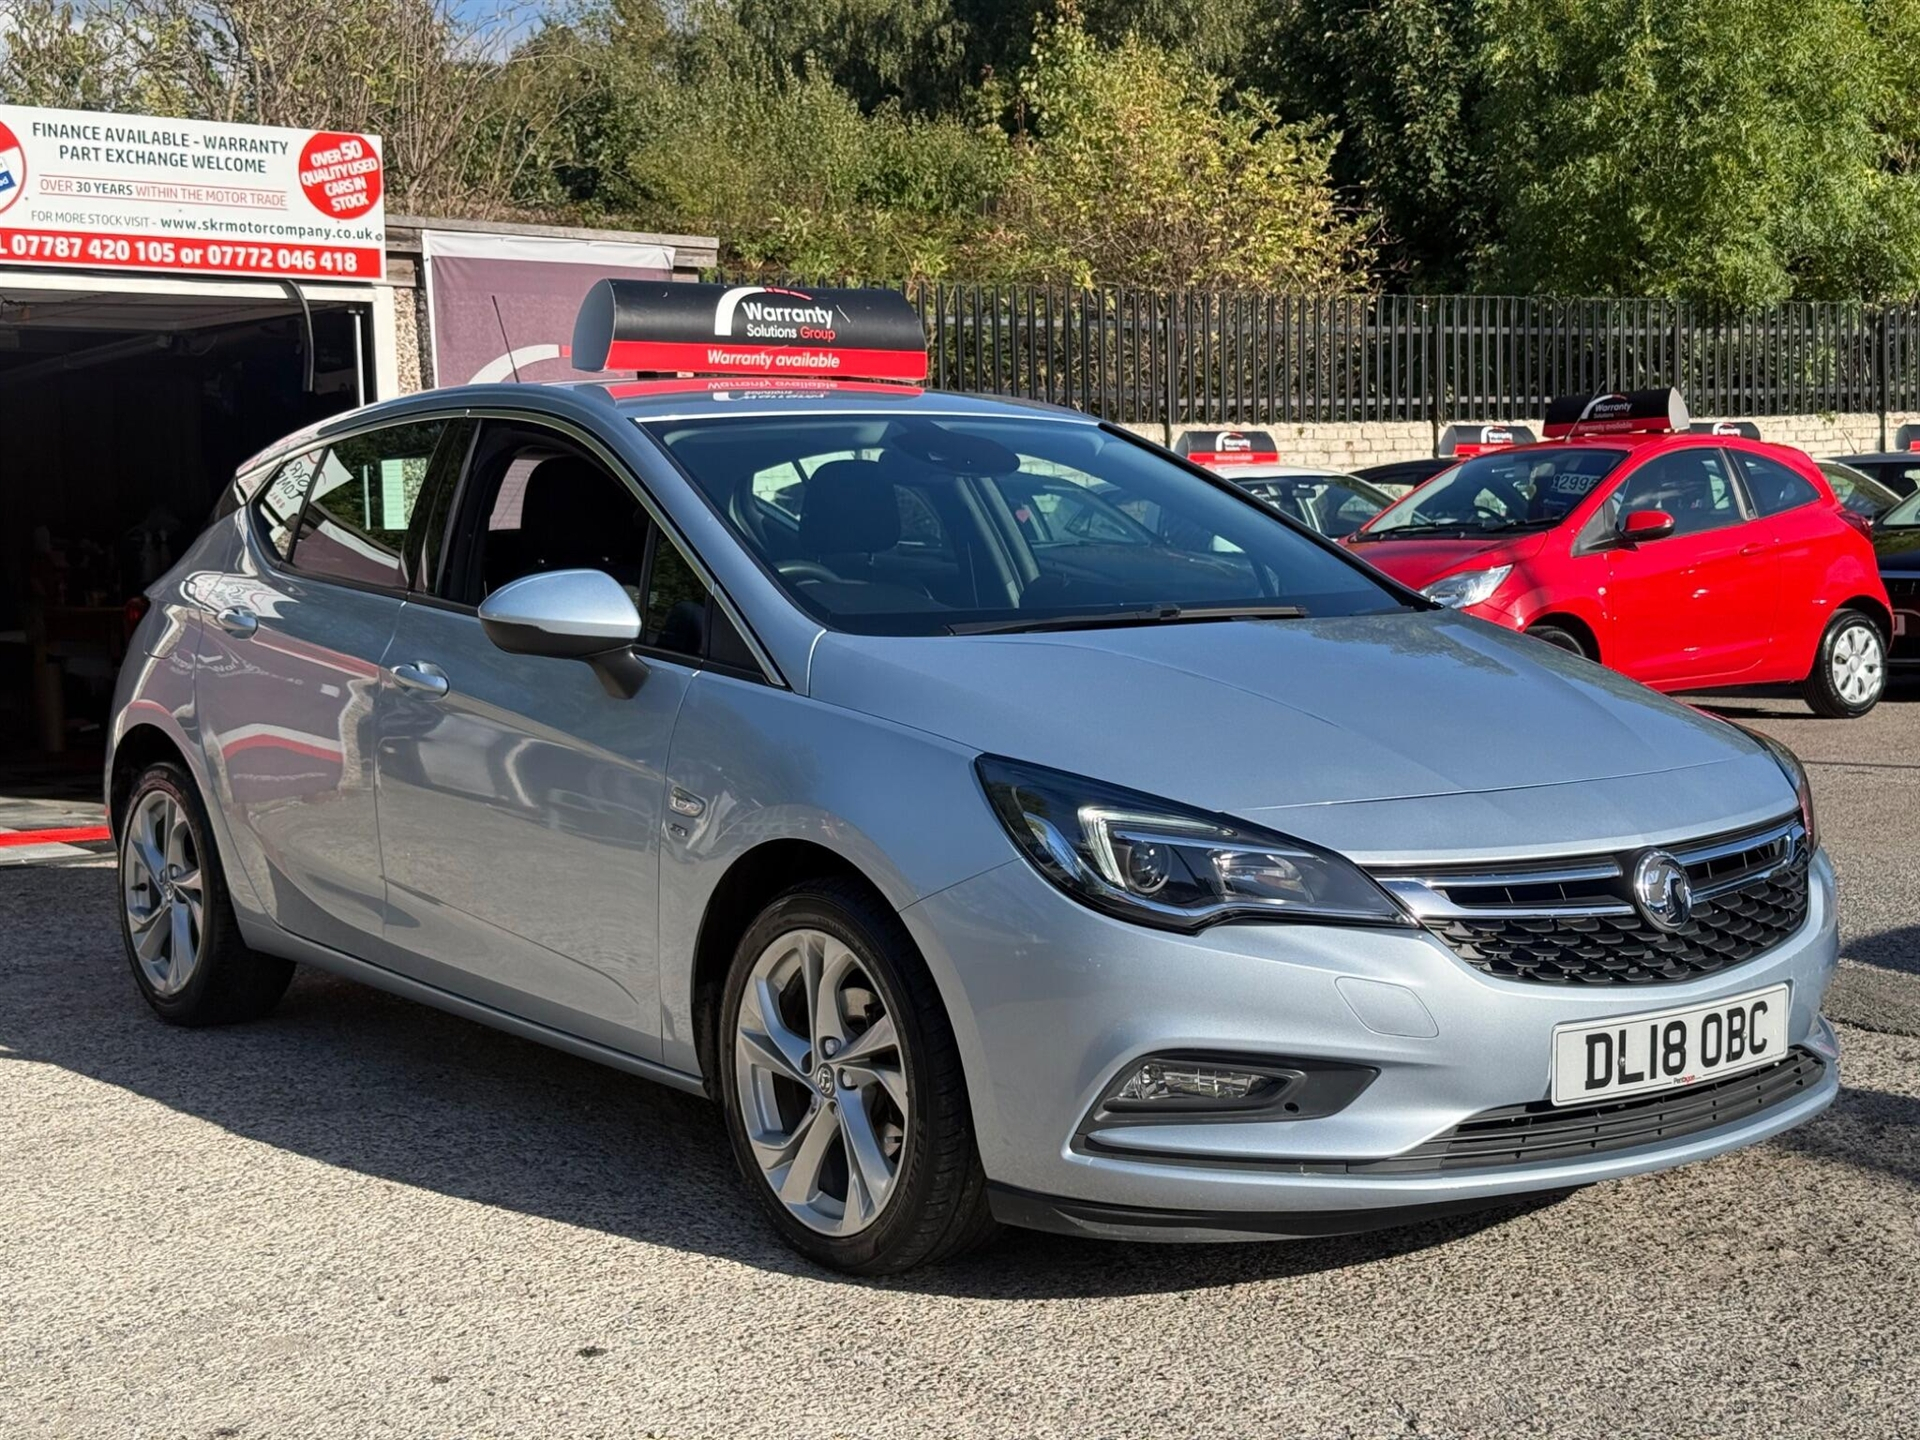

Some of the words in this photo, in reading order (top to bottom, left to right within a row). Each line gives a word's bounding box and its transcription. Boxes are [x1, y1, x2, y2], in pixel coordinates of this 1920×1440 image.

[32, 122, 102, 141] FINANCE
[104, 127, 190, 148] AVAILABLE
[203, 135, 289, 155] WARRANTY
[59, 144, 102, 162] PART
[105, 148, 189, 168] EXCHANGE
[191, 154, 267, 174] WELCOME
[310, 148, 343, 168] OVER
[339, 140, 364, 161] 50
[301, 164, 349, 188] QUALITY
[347, 157, 379, 175] USED
[324, 179, 355, 197] CARS
[352, 175, 368, 191] IN
[40, 178, 74, 192] OVER
[75, 181, 92, 193] 30
[93, 182, 134, 196] YEARS
[135, 185, 178, 199] WITHIN
[180, 187, 203, 201] THE
[205, 190, 248, 204] MOTOR
[249, 192, 287, 207] TRADE
[330, 191, 370, 213] STOCK
[31, 210, 53, 222] FOR
[55, 211, 87, 225] MORE
[88, 213, 123, 227] STOCK
[123, 215, 150, 228] VISIT
[160, 217, 373, 241] www.skrmotorcompany.co.uk
[11, 233, 83, 258] 07787
[87, 238, 131, 261] 420
[133, 240, 176, 264] 105
[179, 247, 204, 265] or
[206, 244, 274, 268] 07772
[276, 248, 316, 271] 046
[319, 251, 358, 273] 418
[741, 301, 833, 330] Warranty
[746, 322, 798, 339] Solutions
[799, 326, 837, 343] Group
[706, 349, 774, 370] Warranty
[775, 352, 841, 369] available
[1595, 402, 1633, 412] Warranty
[1585, 1020, 1687, 1091] DL18
[1701, 1001, 1769, 1069] OBC
